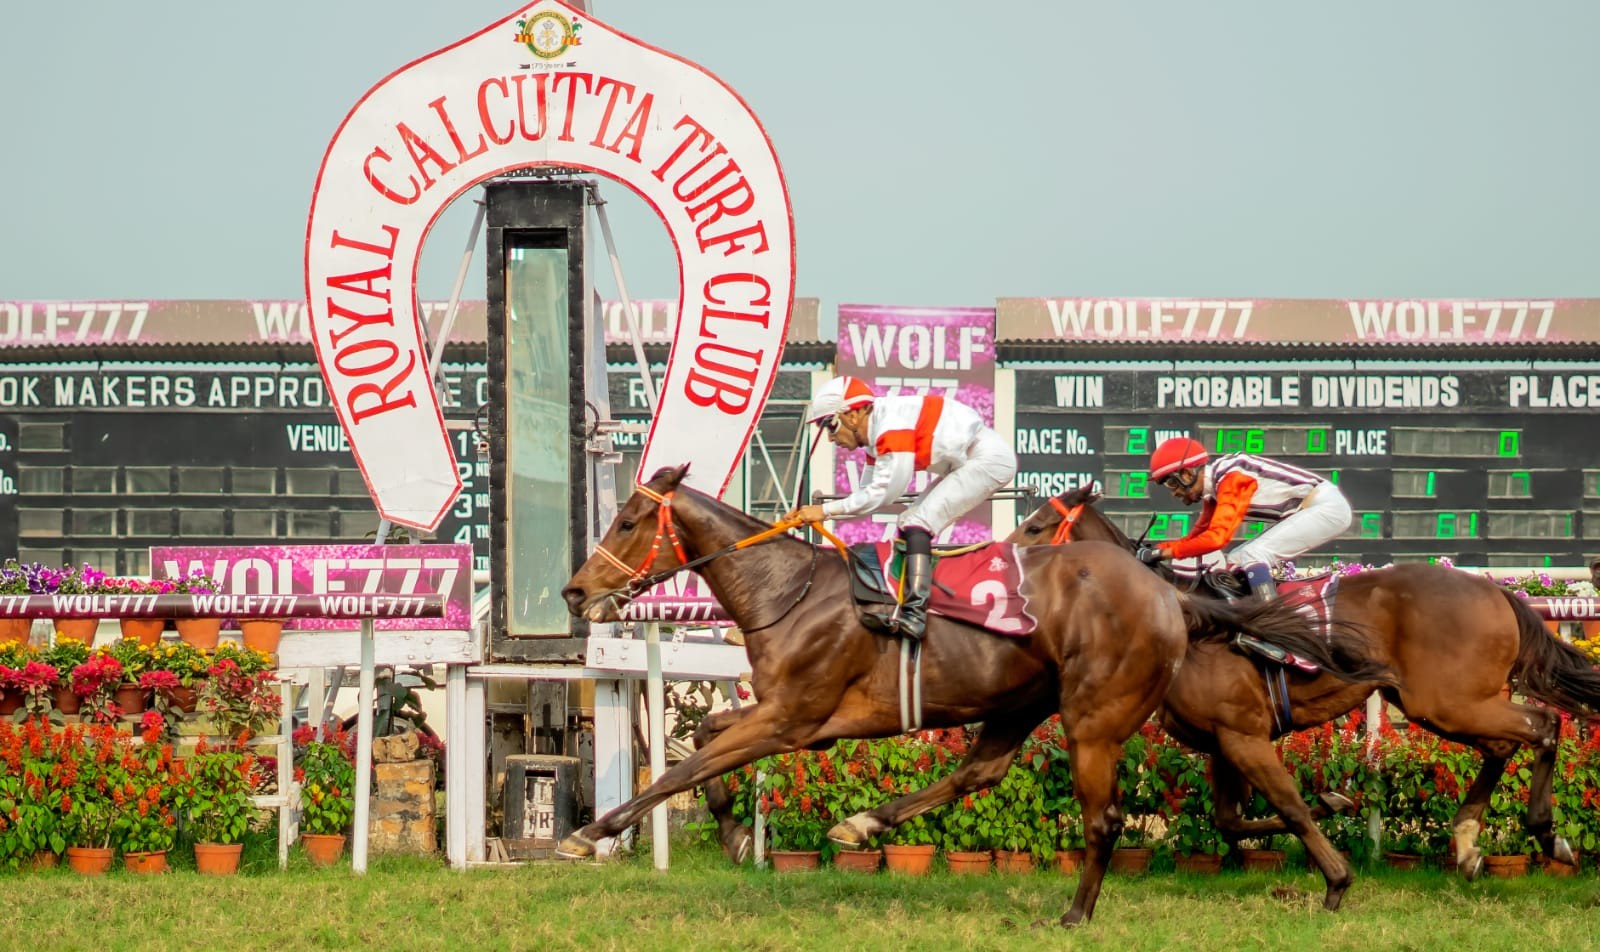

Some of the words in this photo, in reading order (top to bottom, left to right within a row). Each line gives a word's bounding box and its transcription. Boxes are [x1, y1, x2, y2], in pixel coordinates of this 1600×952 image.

[363, 72, 654, 206] CALCUTTA
[651, 114, 770, 257] TURF
[327, 224, 417, 425] ROYAL
[1047, 300, 1253, 338] WOLF777
[1349, 301, 1554, 339] WOLF777
[684, 273, 771, 415] CLUB
[848, 325, 986, 370] WOLF
[54, 376, 196, 406] MAKERS
[208, 376, 336, 407] APPRO
[1055, 376, 1103, 407] WIN
[1157, 376, 1299, 408] PROBABLE
[1311, 376, 1459, 408] DIVIDENDS
[1509, 376, 1600, 408] PLACE
[1016, 429, 1062, 454] RACE
[1066, 429, 1095, 454] No.
[1128, 428, 1147, 454] 2
[1335, 429, 1387, 455] PLACE
[1017, 472, 1077, 498] HORSE
[1119, 472, 1148, 497] 12
[53, 594, 158, 613] WOLF777
[192, 595, 298, 614] WOLF777
[319, 595, 426, 616] WOLF777
[971, 580, 1022, 632] 2
